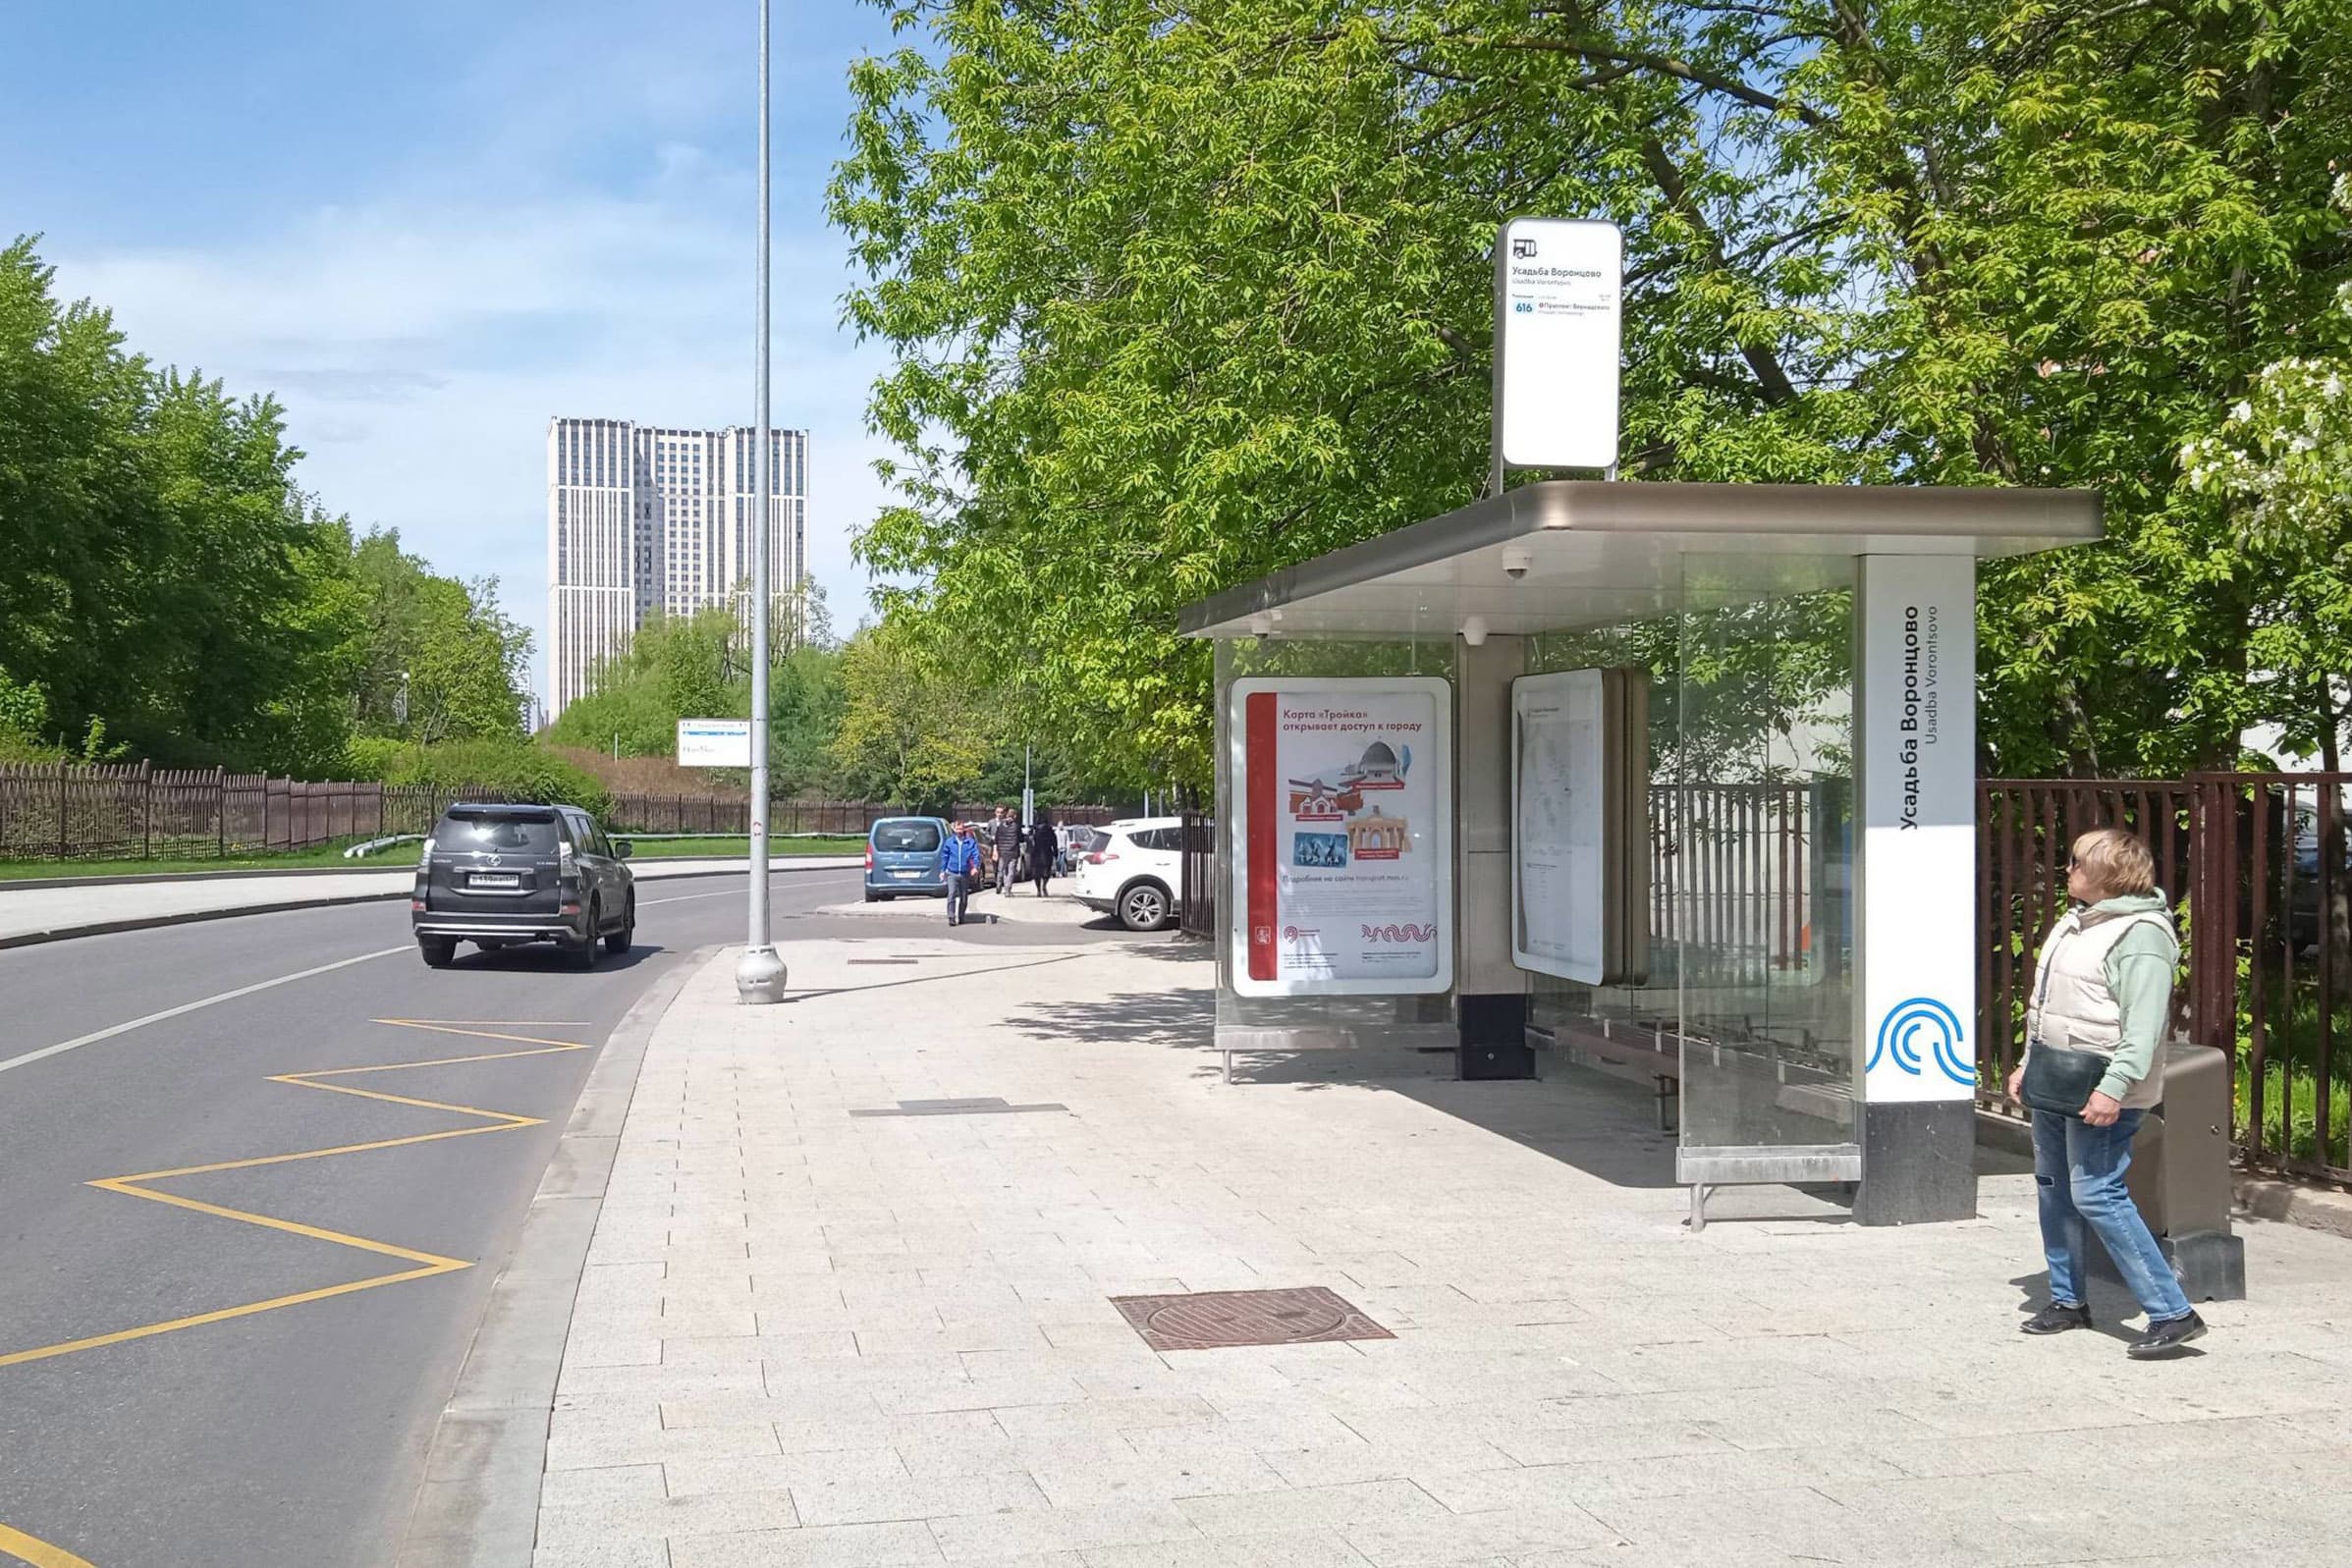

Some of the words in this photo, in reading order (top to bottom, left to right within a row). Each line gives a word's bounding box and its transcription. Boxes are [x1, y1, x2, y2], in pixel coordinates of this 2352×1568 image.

[1512, 267, 1549, 277] Усадьба
[1551, 268, 1602, 278] Воронцово
[1515, 302, 1533, 312] 616
[1925, 605, 1938, 688] Vorontsovo
[1900, 605, 1922, 731] Воронцово
[1283, 709, 1316, 721] Карта
[1319, 709, 1368, 721] «Тройка»
[1283, 722, 1338, 732] открывает
[1340, 723, 1376, 733] доступ
[1386, 723, 1422, 732] городу
[1925, 690, 1938, 745] Usadba
[1900, 738, 1919, 831] Усадьба
